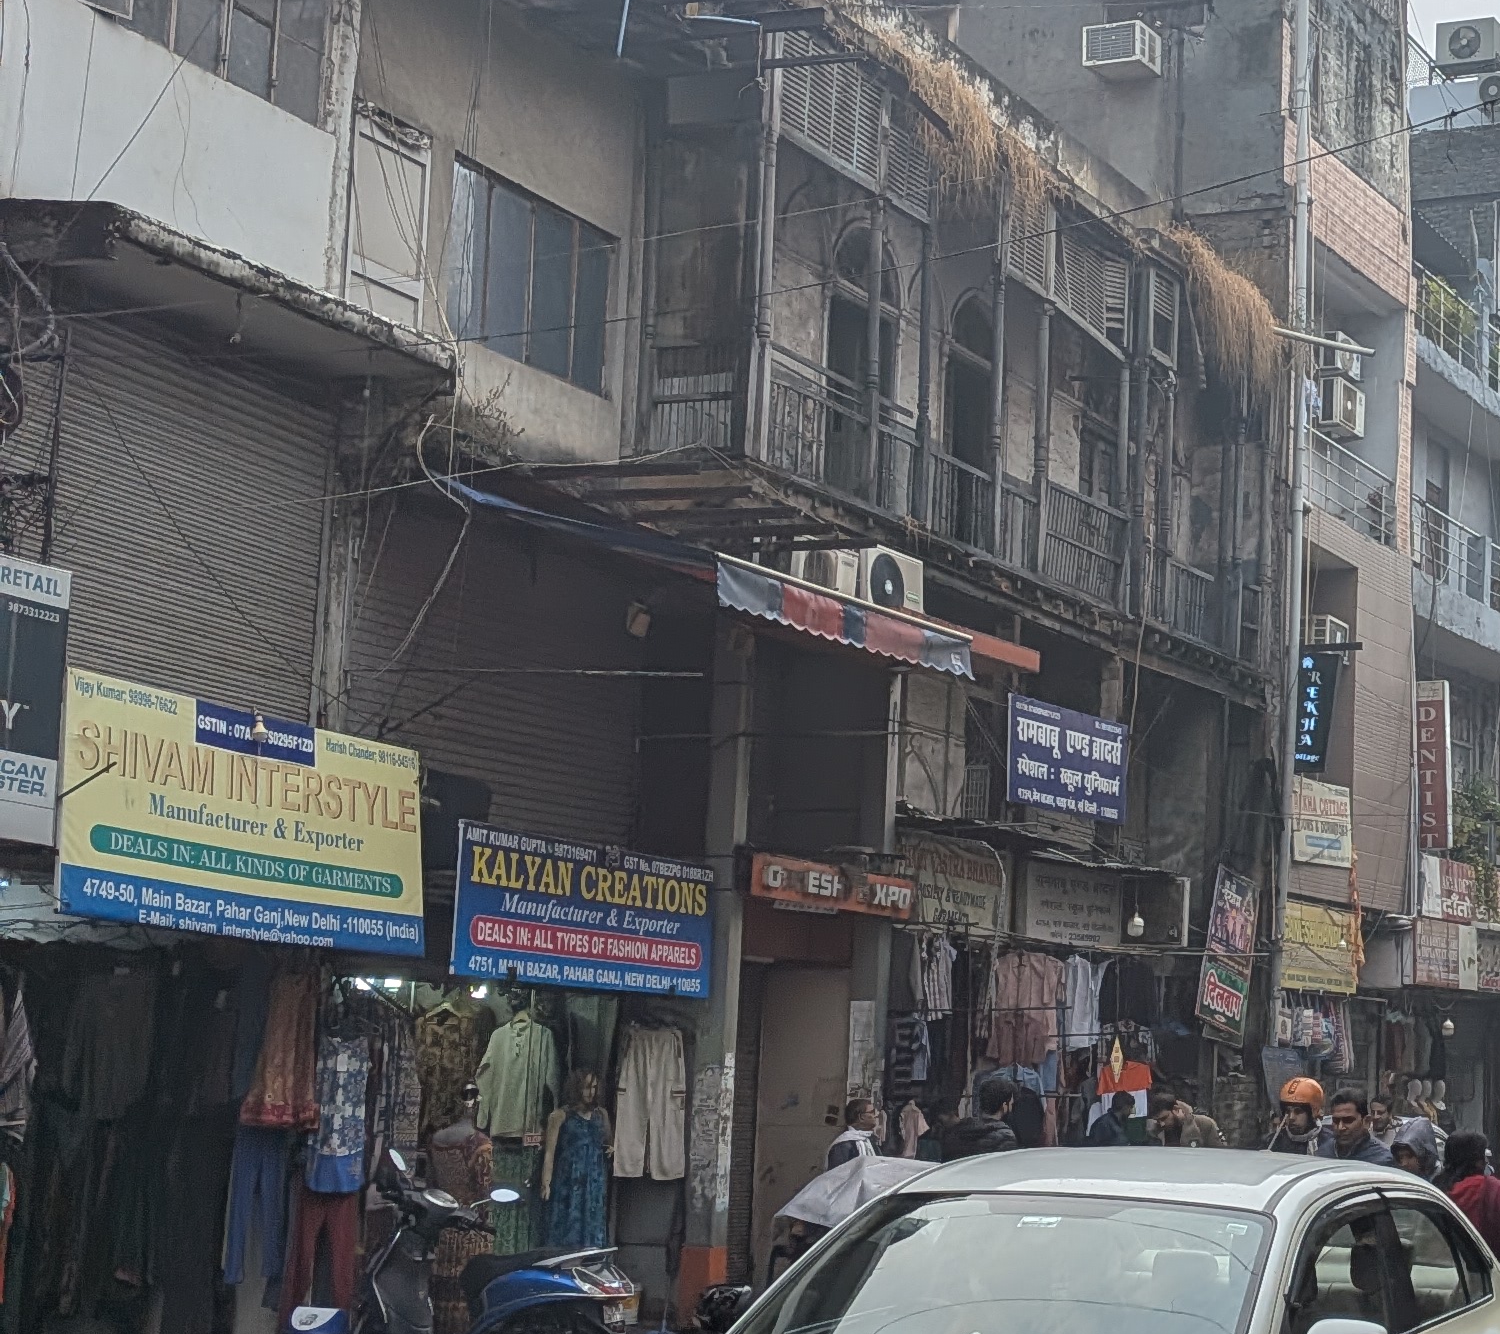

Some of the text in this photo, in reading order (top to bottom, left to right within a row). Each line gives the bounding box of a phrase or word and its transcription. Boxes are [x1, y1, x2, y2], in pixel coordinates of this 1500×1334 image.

[0, 565, 63, 598] RETAIL
[197, 714, 227, 736] GSTIN
[1016, 716, 1062, 760] रामबाबू
[1065, 729, 1091, 757] एण्ड
[0, 758, 47, 781] CAN
[76, 719, 417, 834] SHIVAM INTERSTYLE
[1016, 752, 1049, 780] स्पेशल
[1419, 706, 1439, 849] DENTIST
[148, 791, 364, 852] Manufacturer & Exporter
[466, 825, 489, 844] AMIT
[488, 830, 519, 849] KUMAR
[520, 836, 547, 854] GUPTA
[110, 831, 392, 894] DEALS IN: ALL KINDS OF GARMENTS
[470, 845, 708, 918] KALYAN CREATIONS
[82, 876, 138, 907] 4749-50,
[141, 886, 172, 909] Main
[175, 892, 212, 919] Bazar,
[216, 899, 252, 922] Pahar
[311, 912, 340, 932] Delhi
[342, 916, 384, 937] -110055
[385, 920, 420, 945] (India)
[499, 892, 681, 936] Manufacturer & Exporter
[477, 921, 697, 966] DEALS IN: ALL TYPES OF FASHION APPARELS
[468, 954, 496, 976] 4751,
[526, 961, 561, 983] BAZAR,
[563, 965, 594, 983] PAHAR
[596, 969, 622, 988] GANJ,
[624, 971, 645, 988] NEW
